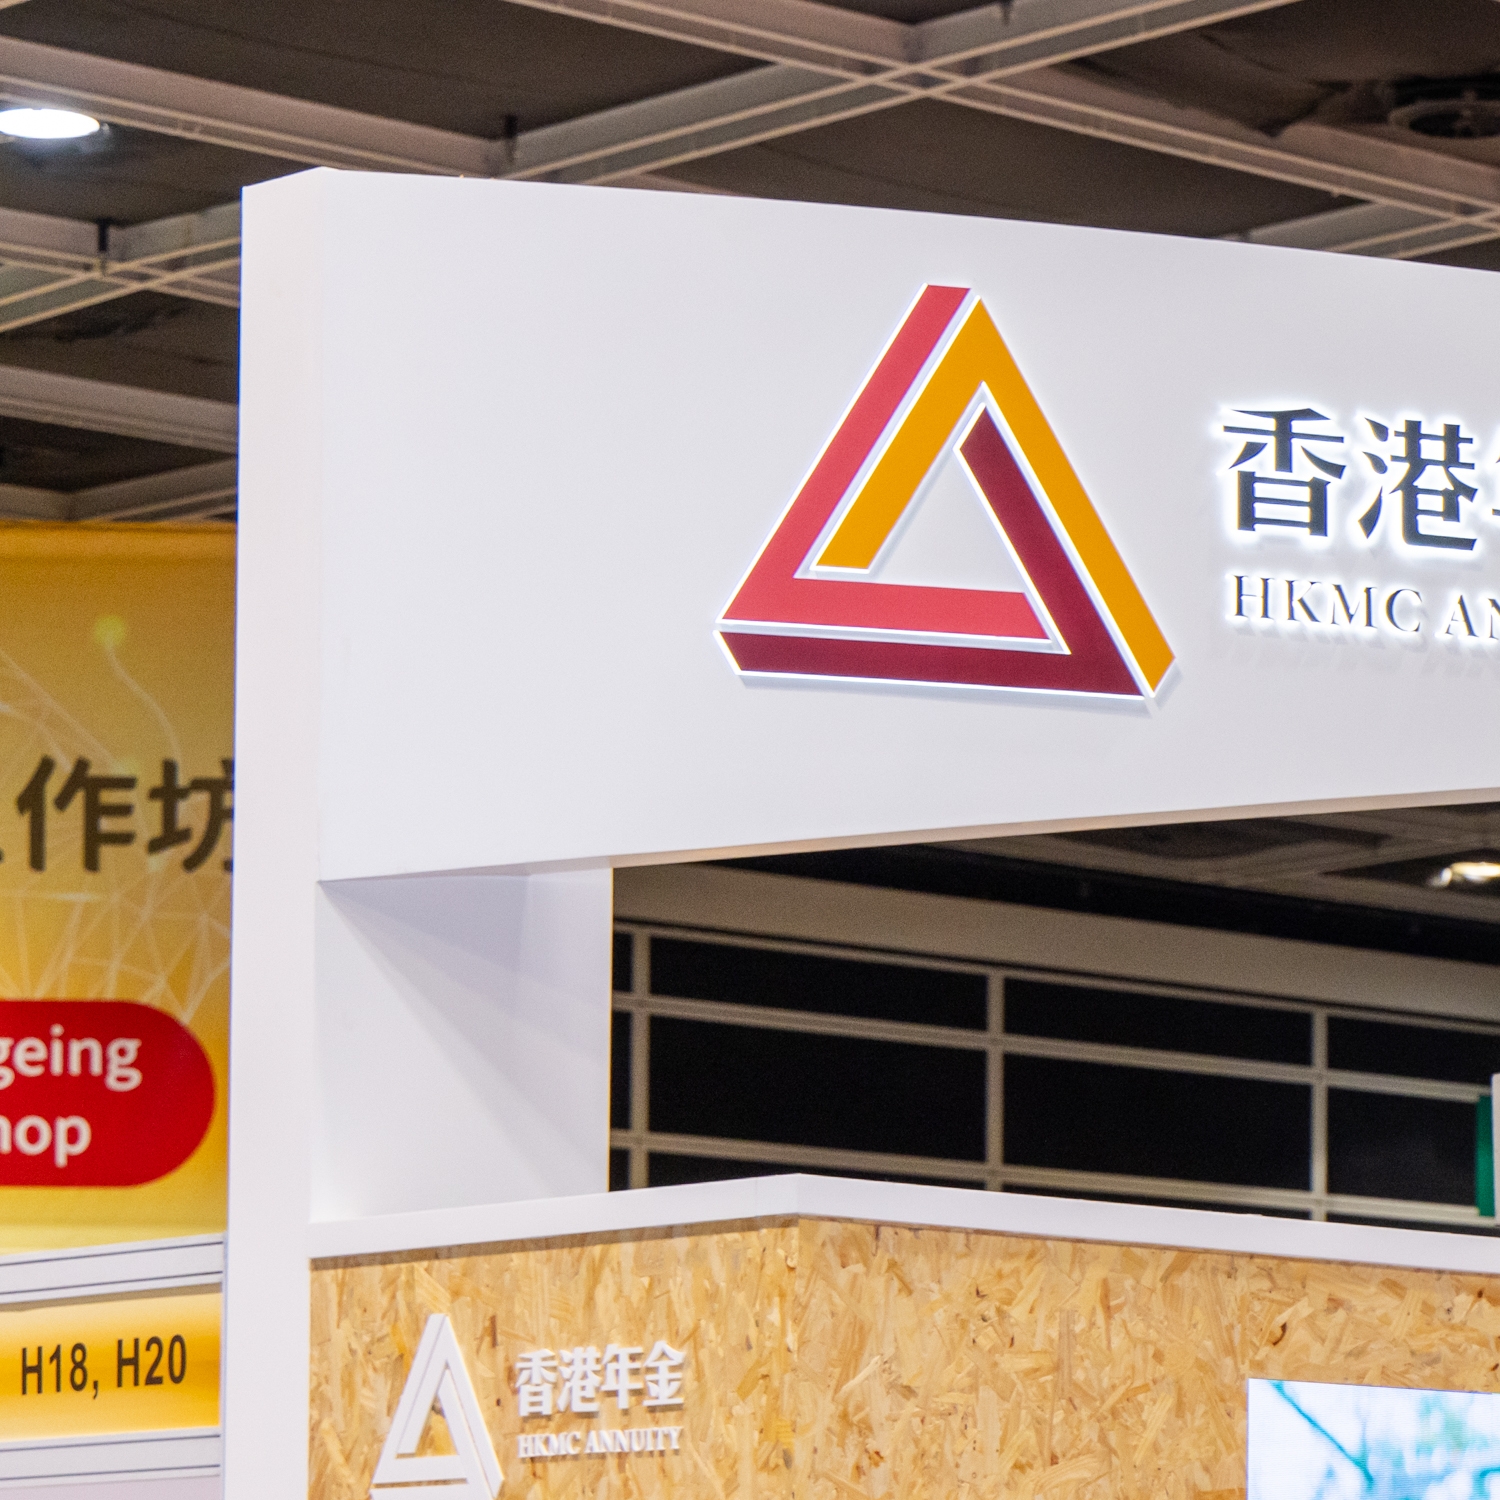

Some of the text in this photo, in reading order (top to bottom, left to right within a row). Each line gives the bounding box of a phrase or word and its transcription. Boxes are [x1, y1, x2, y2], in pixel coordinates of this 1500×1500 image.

[1232, 574, 1423, 634] HKMC
[0, 754, 234, 873] 作坊
[21, 1334, 188, 1400] H18, H20
[515, 1340, 687, 1417] 香港年金
[517, 1426, 684, 1459] HKMC ANNUITY
